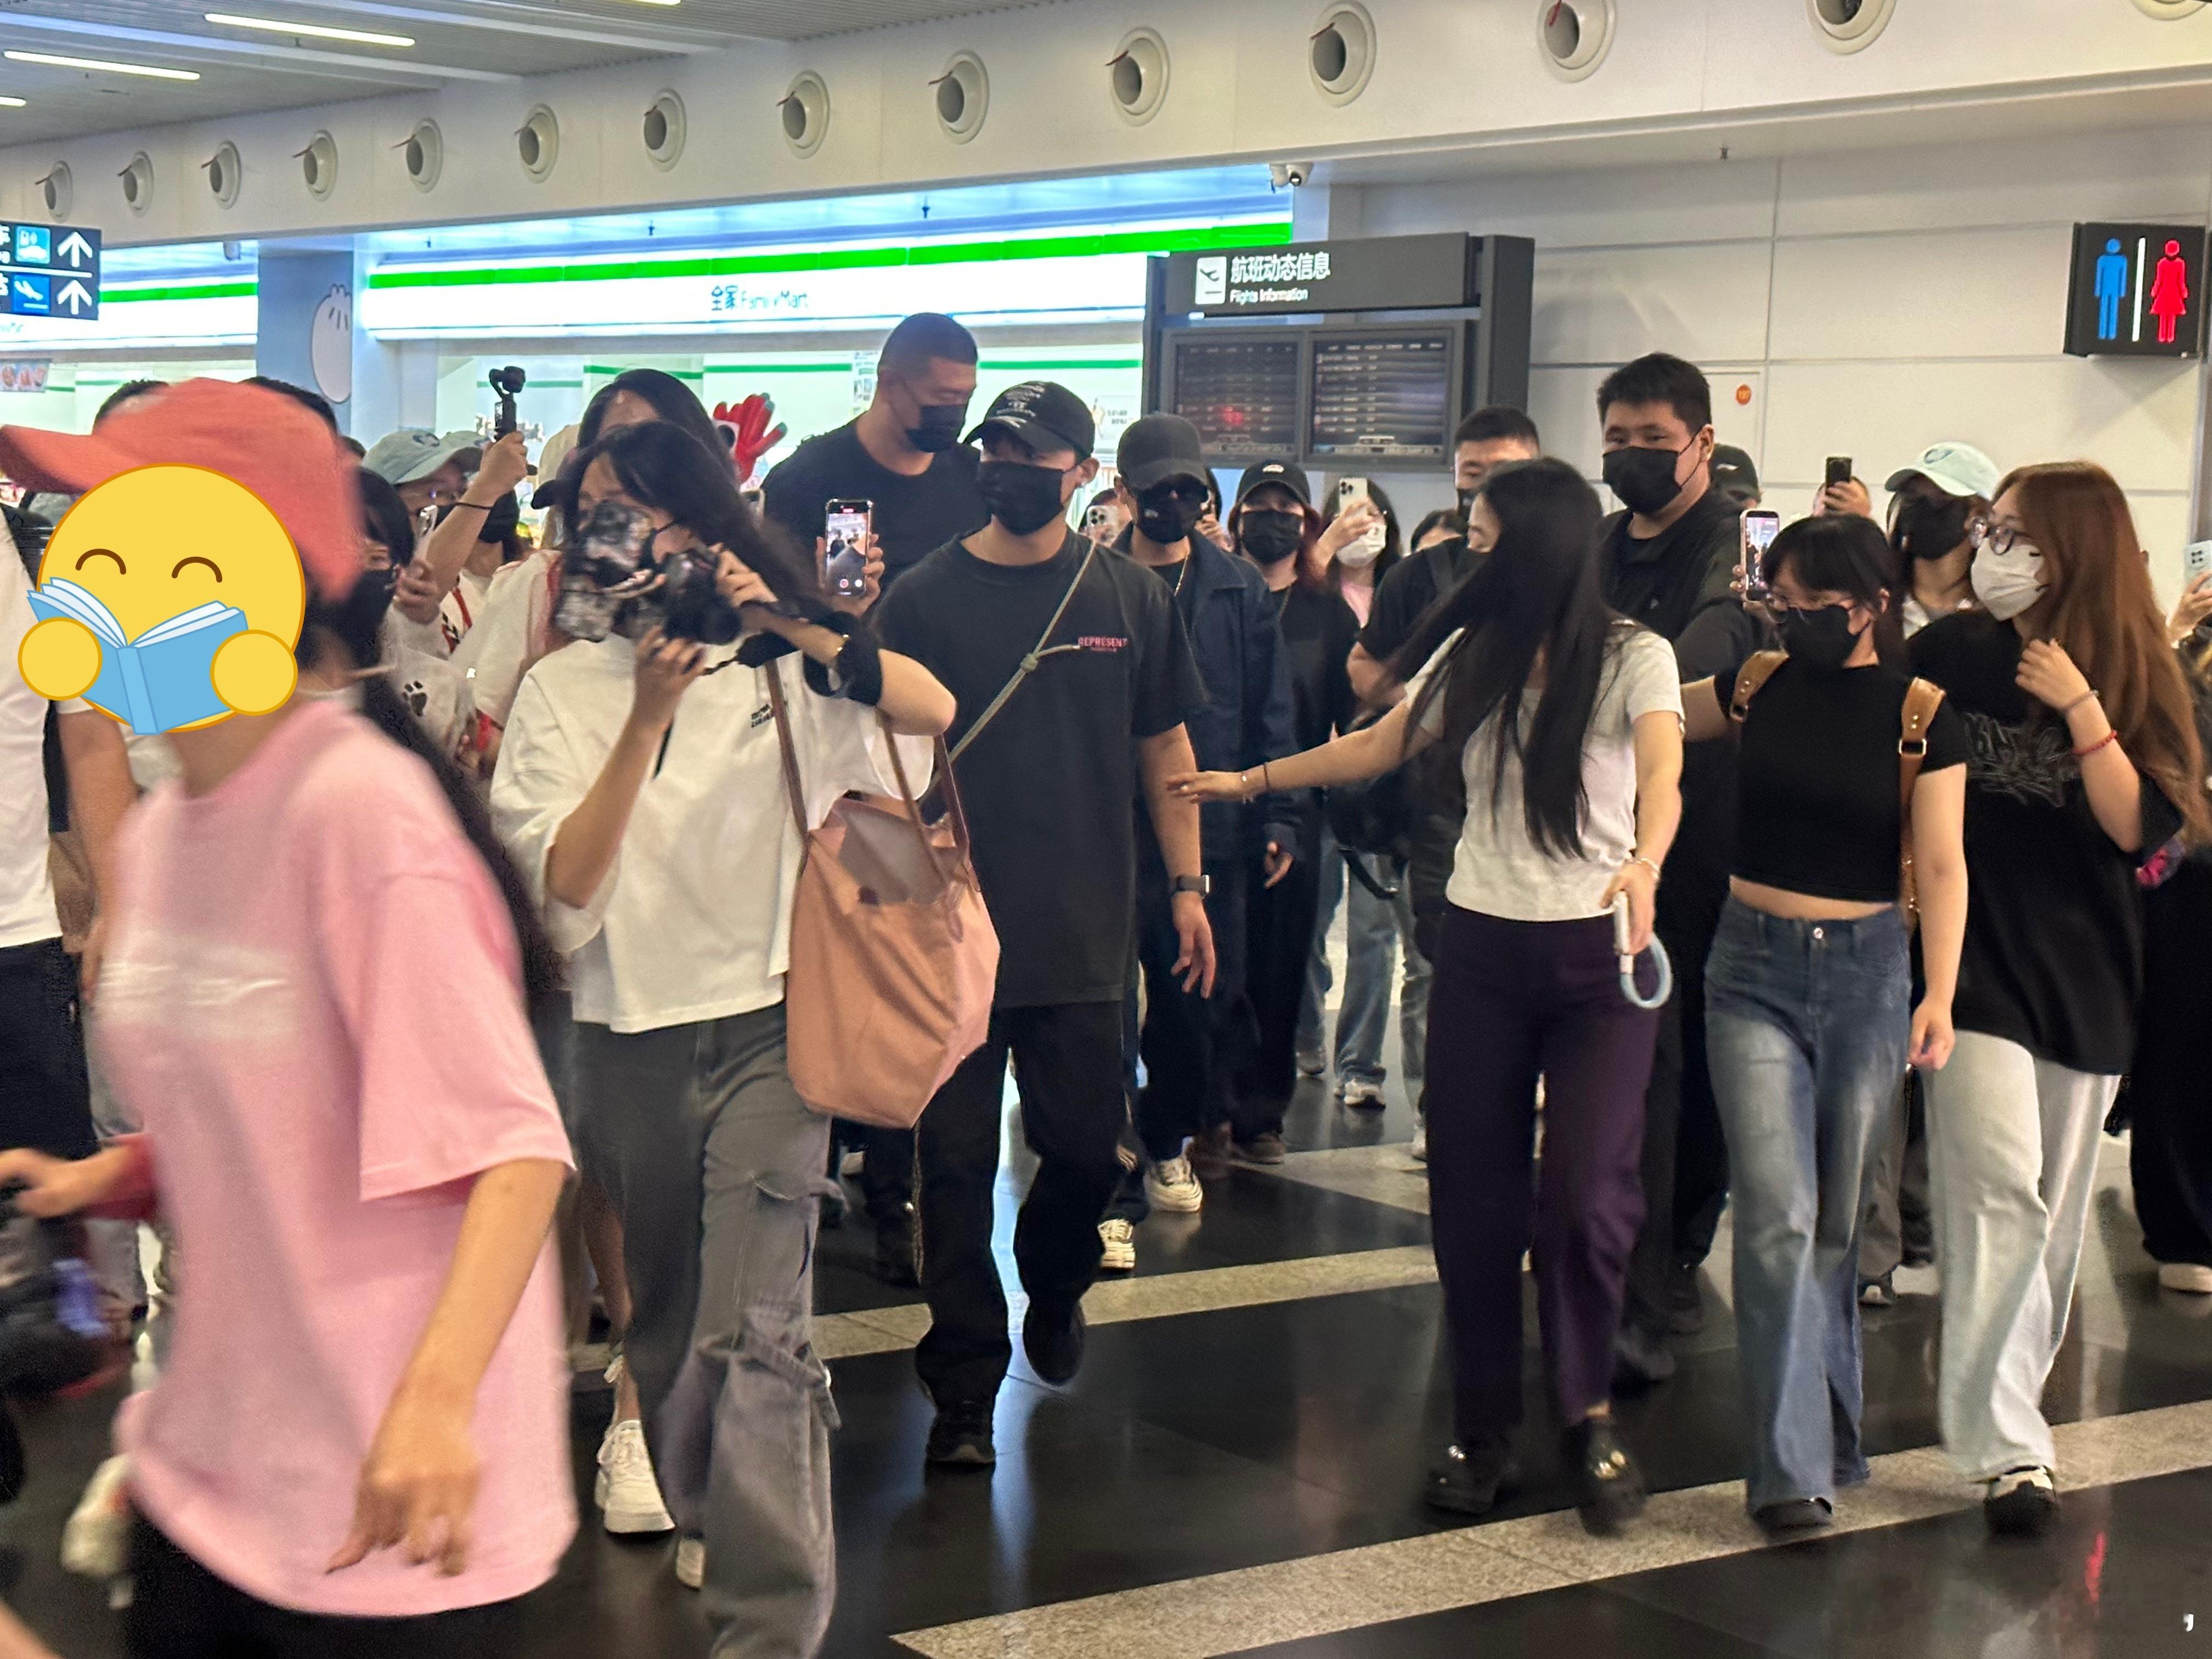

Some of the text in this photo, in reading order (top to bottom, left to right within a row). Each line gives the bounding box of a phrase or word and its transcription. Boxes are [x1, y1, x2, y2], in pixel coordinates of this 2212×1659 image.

[1231, 251, 1331, 283] 航班动态信息
[741, 290, 808, 314] FamyMart
[1078, 636, 1128, 647] REPRESENT
